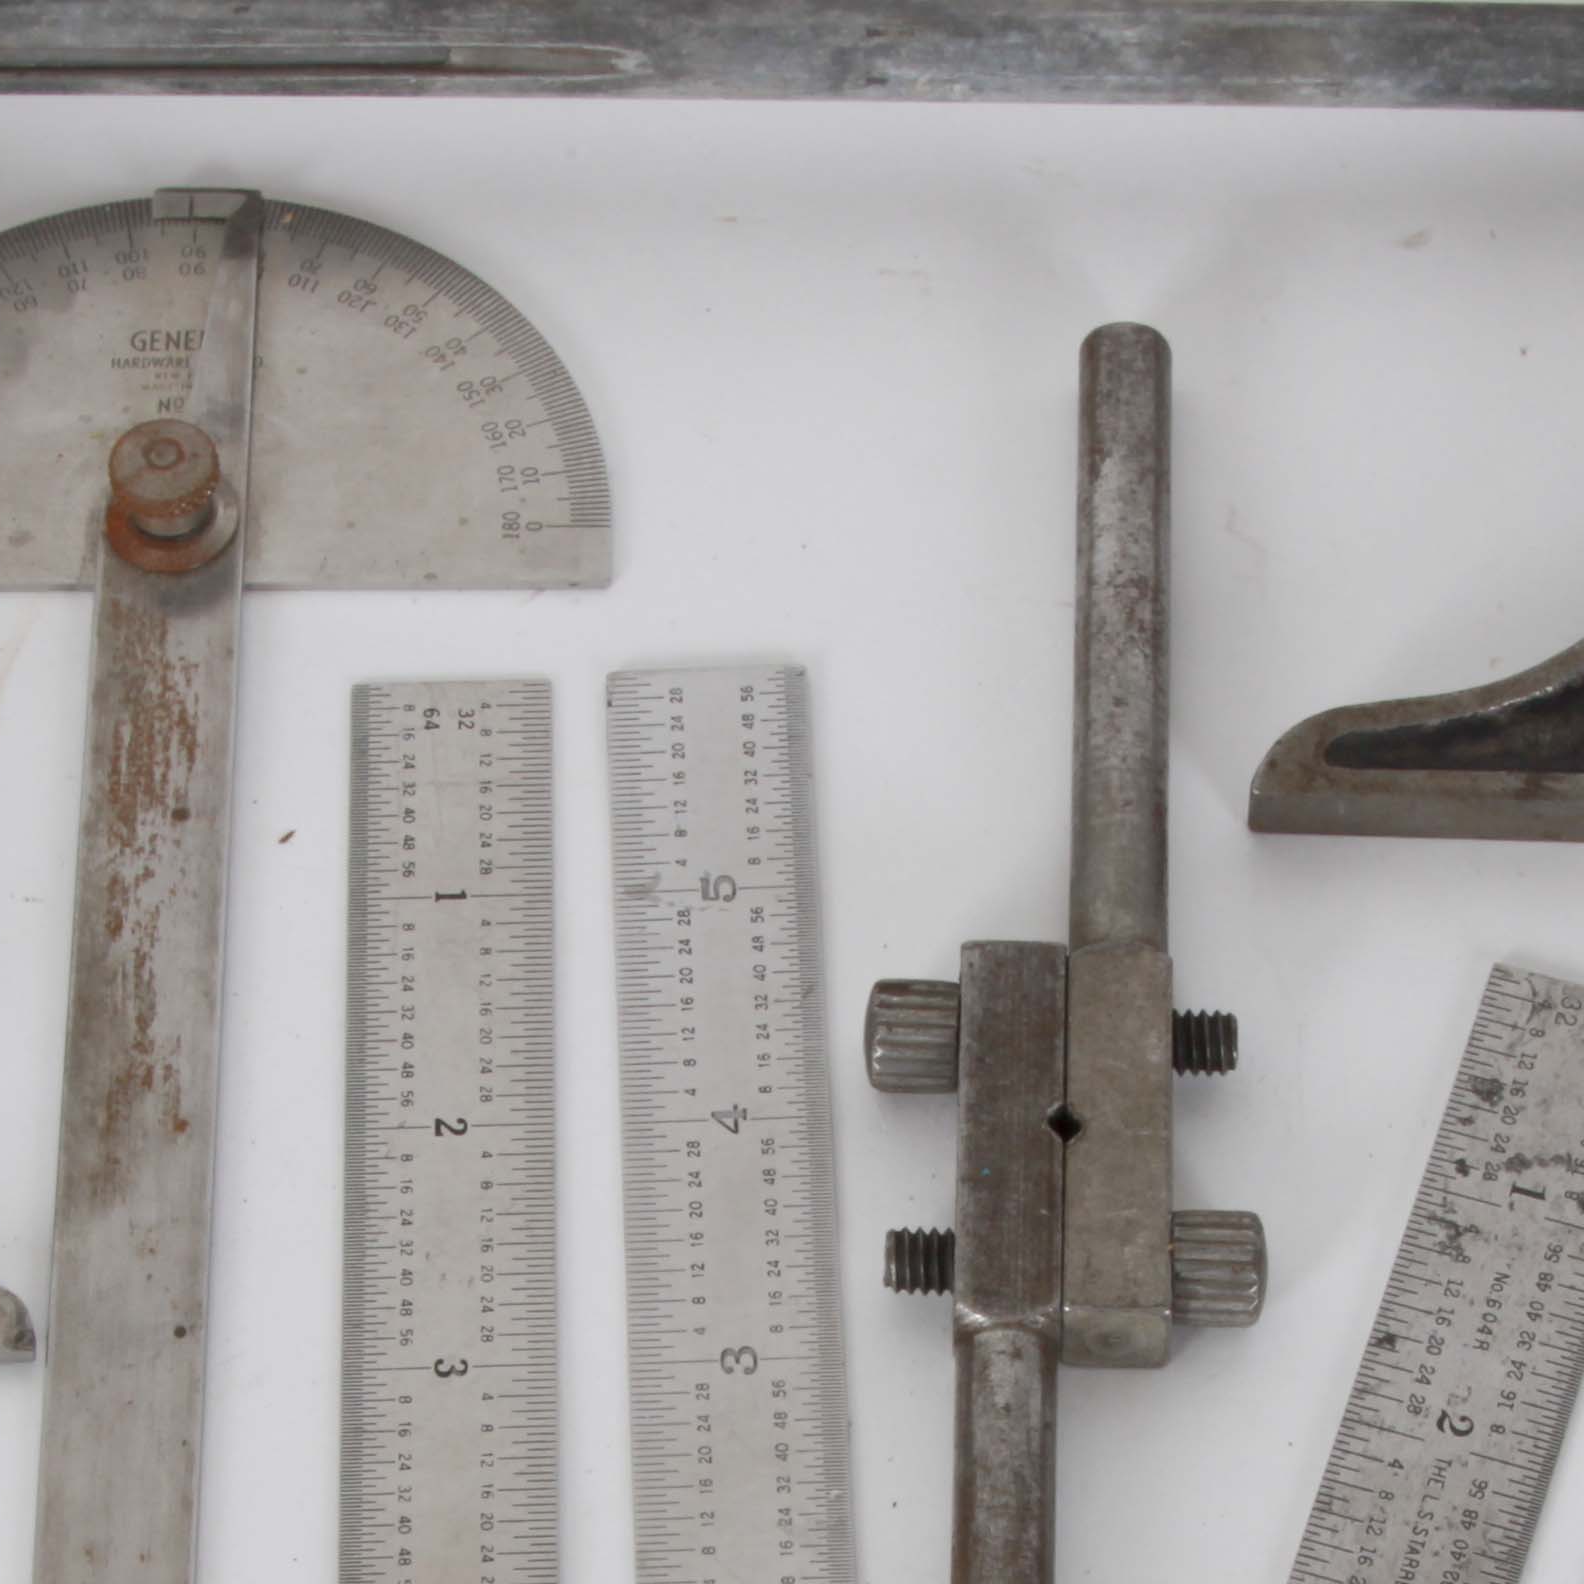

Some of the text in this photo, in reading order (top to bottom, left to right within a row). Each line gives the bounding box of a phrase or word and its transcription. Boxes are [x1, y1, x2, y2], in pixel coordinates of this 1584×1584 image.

[423, 708, 440, 730] 64
[458, 709, 475, 730] 32
[699, 874, 737, 903] 5
[435, 1118, 468, 1137] 2
[711, 1104, 747, 1135] 4
[1510, 1182, 1546, 1201] 1
[434, 1358, 468, 1378] 3
[720, 1346, 758, 1375] 3
[1436, 1409, 1474, 1437] 2
[1426, 1458, 1452, 1489] THE
